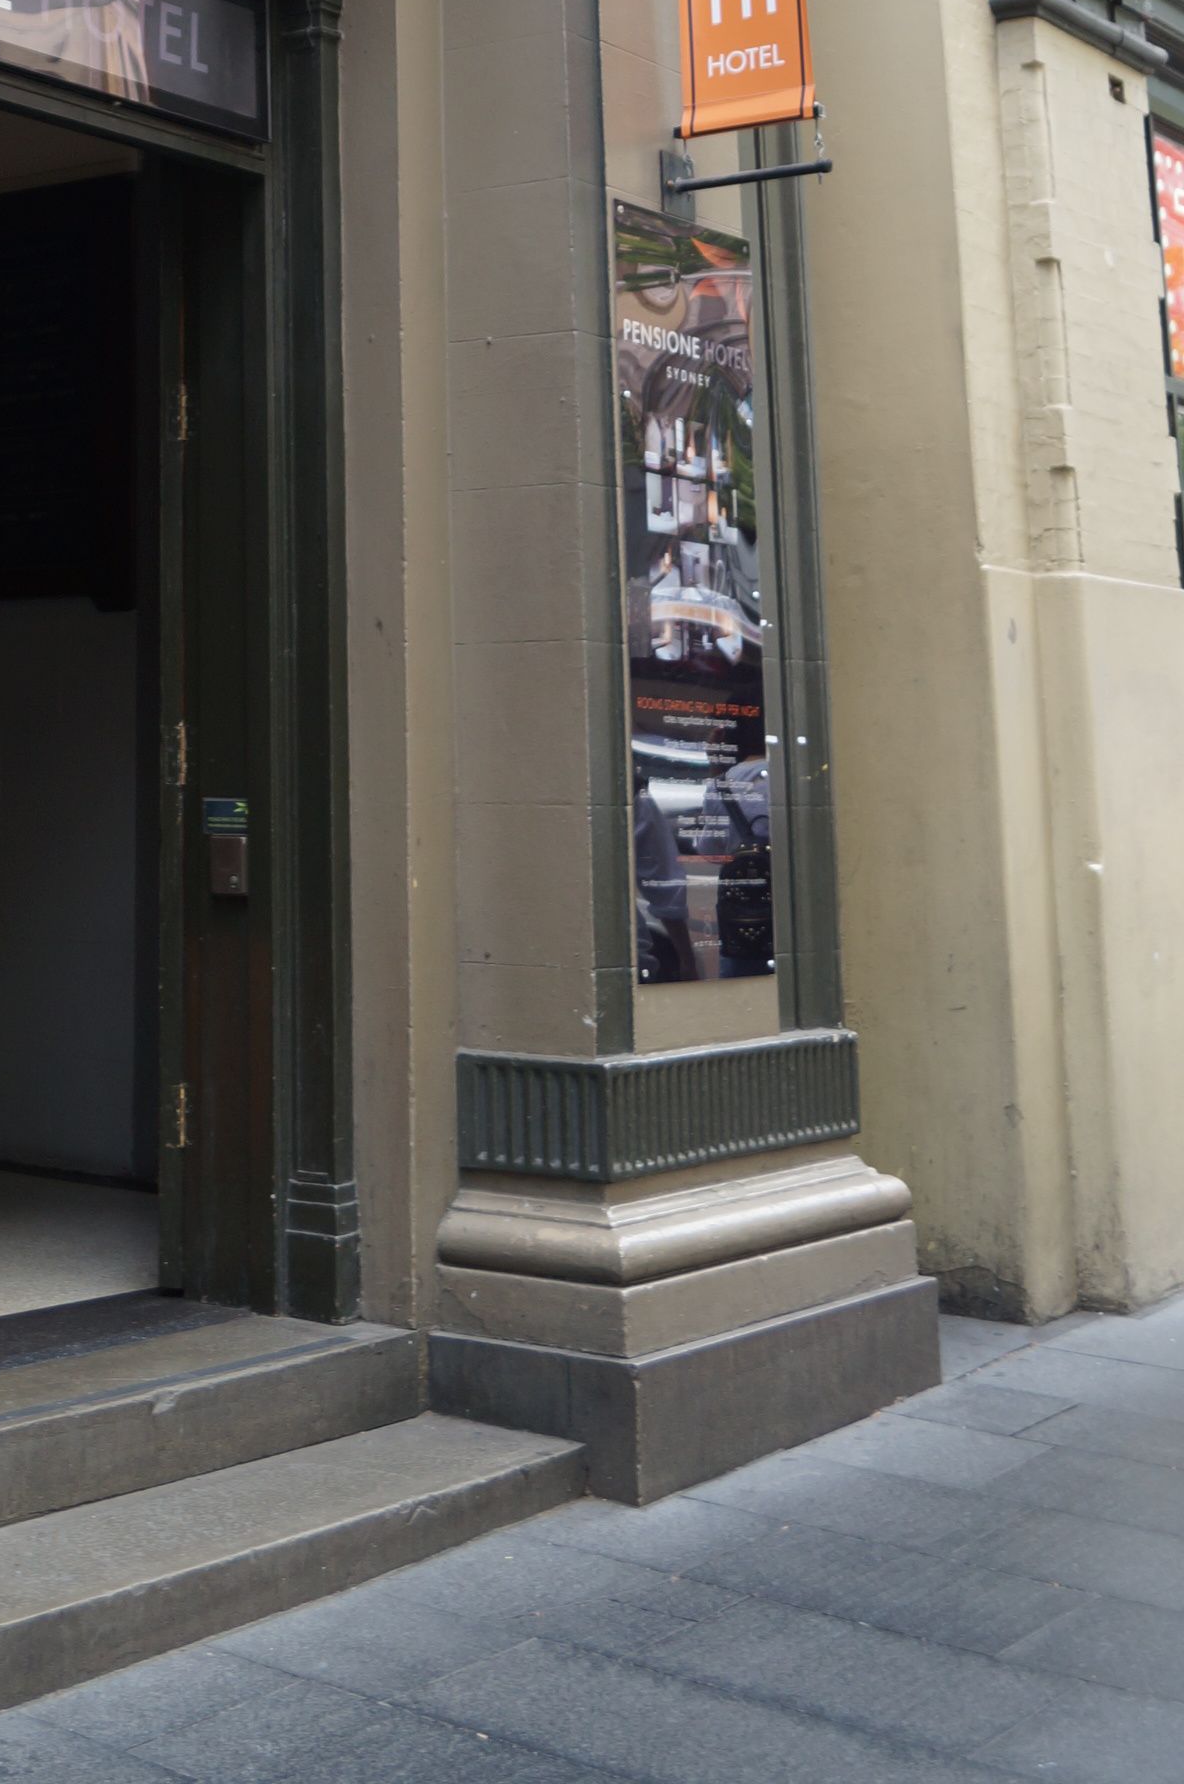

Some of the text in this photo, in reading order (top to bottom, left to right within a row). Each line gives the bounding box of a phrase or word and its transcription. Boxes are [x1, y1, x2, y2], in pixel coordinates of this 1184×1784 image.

[706, 42, 786, 78] HOTEL
[622, 318, 750, 372] PENSIONE HOTEL
[665, 365, 712, 388] SYDNEY
